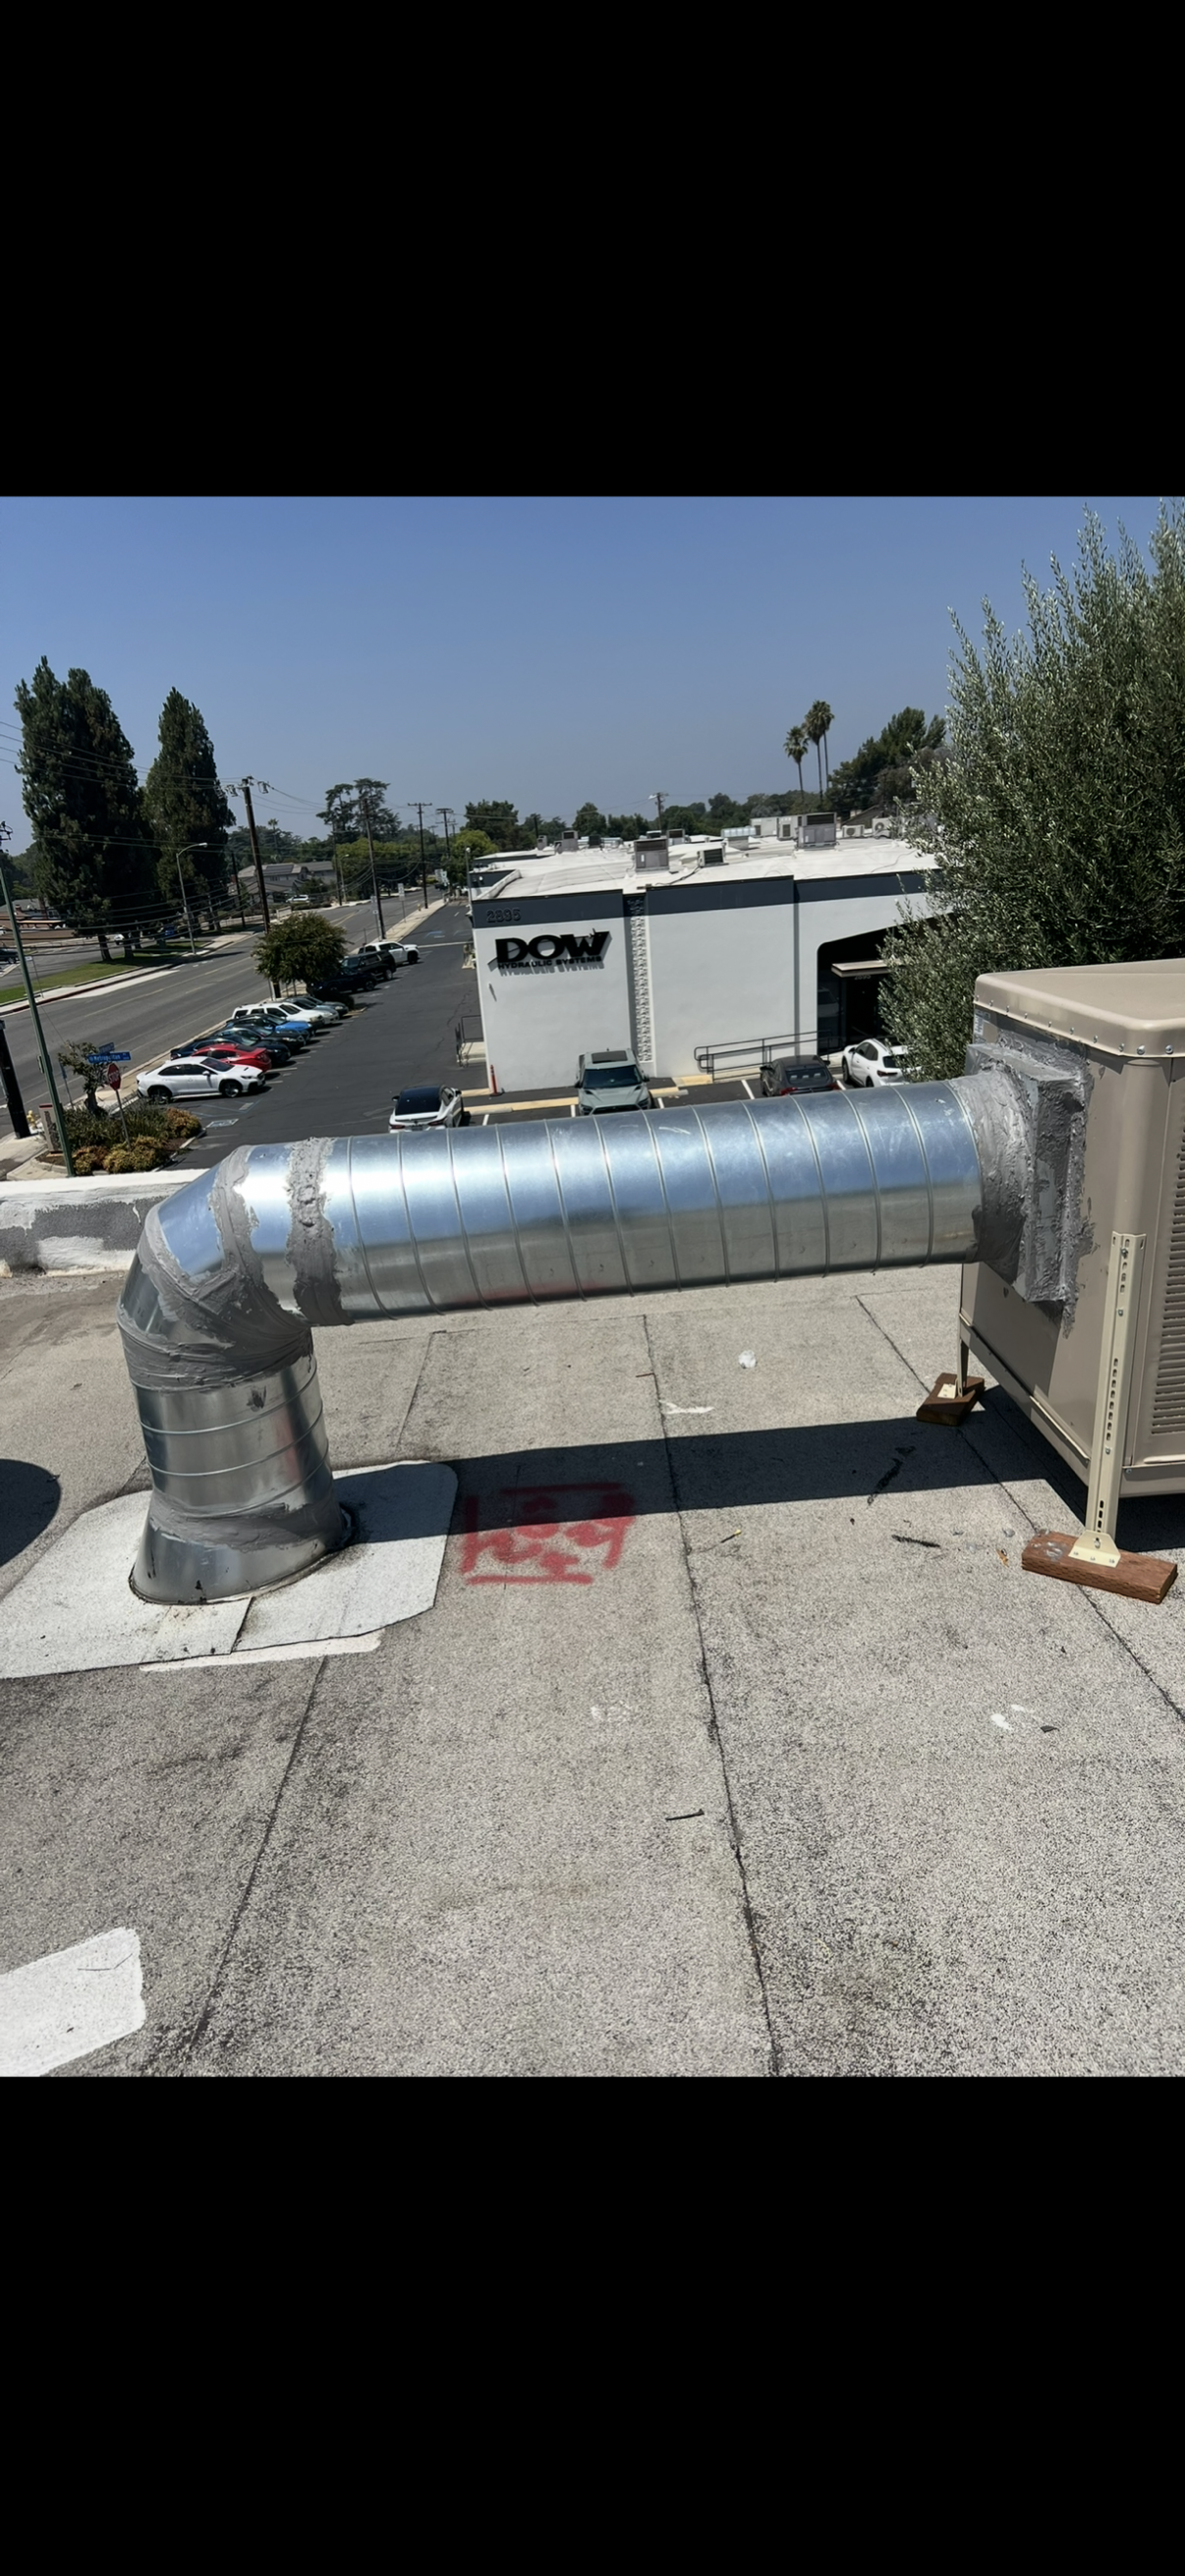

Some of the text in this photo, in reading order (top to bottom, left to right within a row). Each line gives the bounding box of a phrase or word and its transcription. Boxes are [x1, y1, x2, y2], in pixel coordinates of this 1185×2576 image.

[495, 930, 609, 963] DOW
[498, 956, 602, 970] HYDRAULIC SYSTEMS
